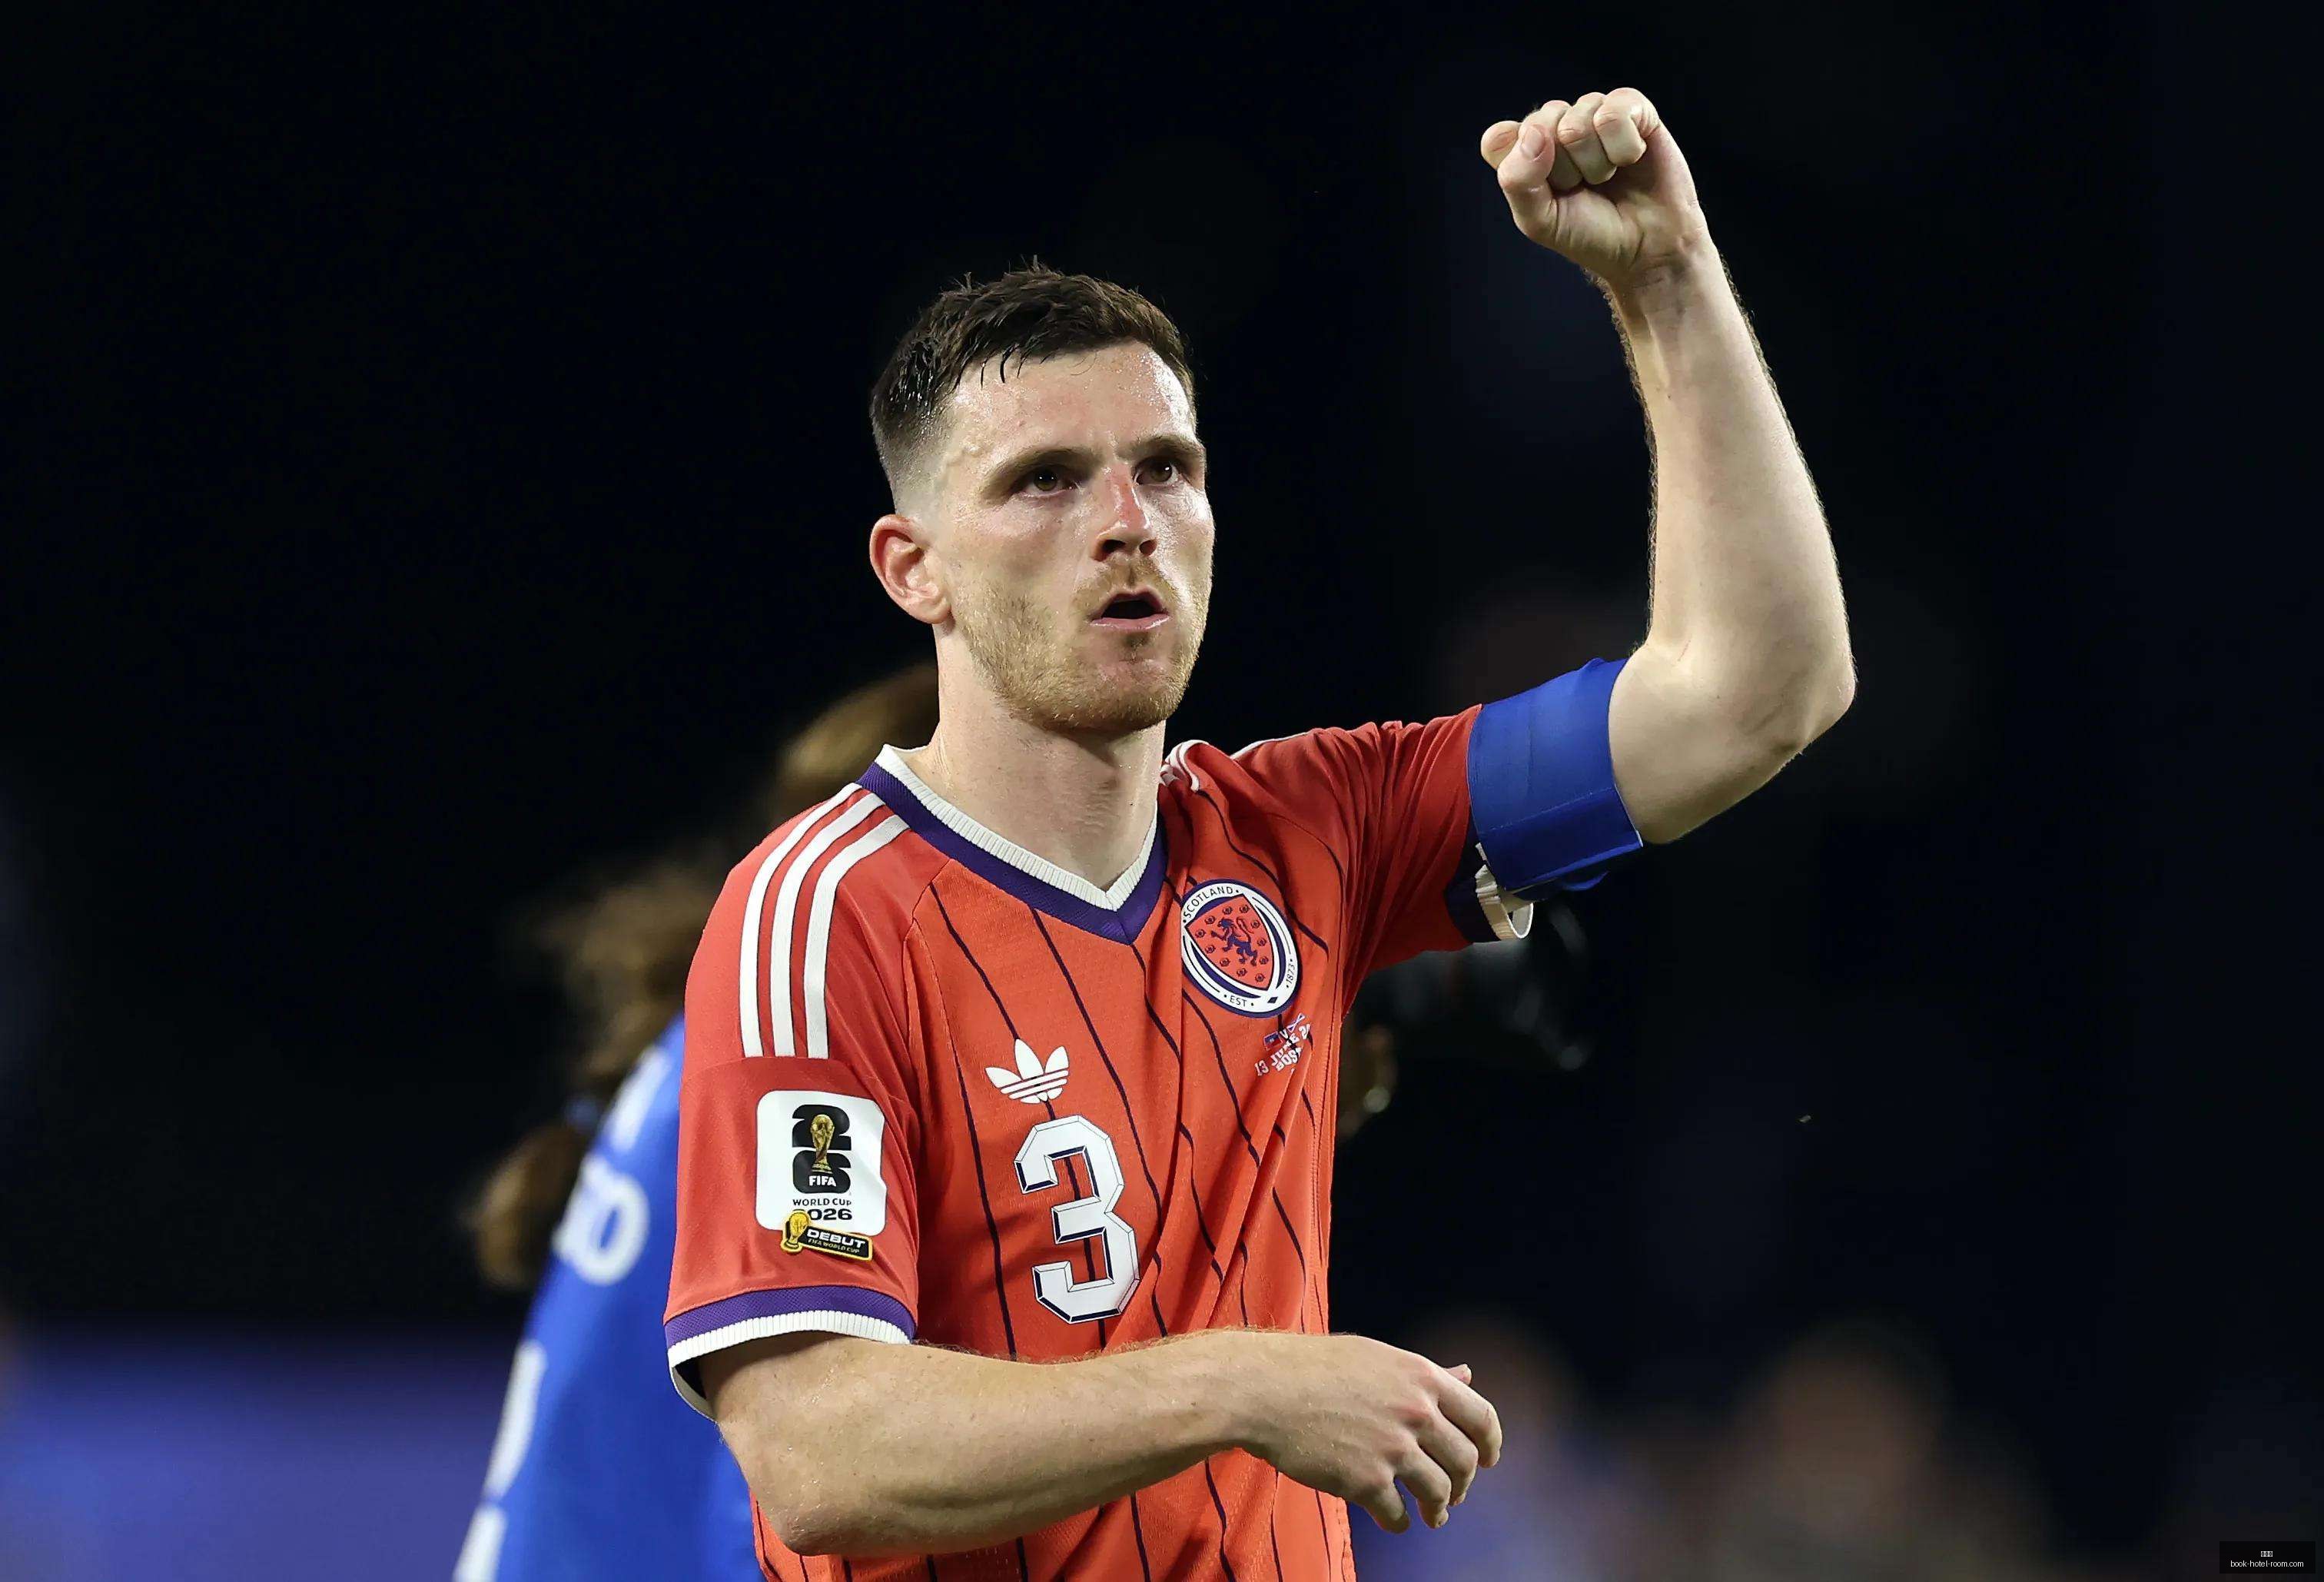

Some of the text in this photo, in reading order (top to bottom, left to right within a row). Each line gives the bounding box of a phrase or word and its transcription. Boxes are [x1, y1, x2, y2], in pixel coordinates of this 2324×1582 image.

[1184, 886, 1233, 919] SCOTLAND
[1286, 962, 1296, 984] 1873
[1230, 995, 1247, 1007] EST
[1254, 1060, 1269, 1076] 13
[808, 1175, 837, 1187] FIFA
[792, 1198, 852, 1206] WORLD CUP
[792, 1208, 853, 1221] 026
[1014, 1115, 1140, 1324] 3
[807, 1228, 865, 1248] DEBUT
[823, 1241, 846, 1251] WORLD
